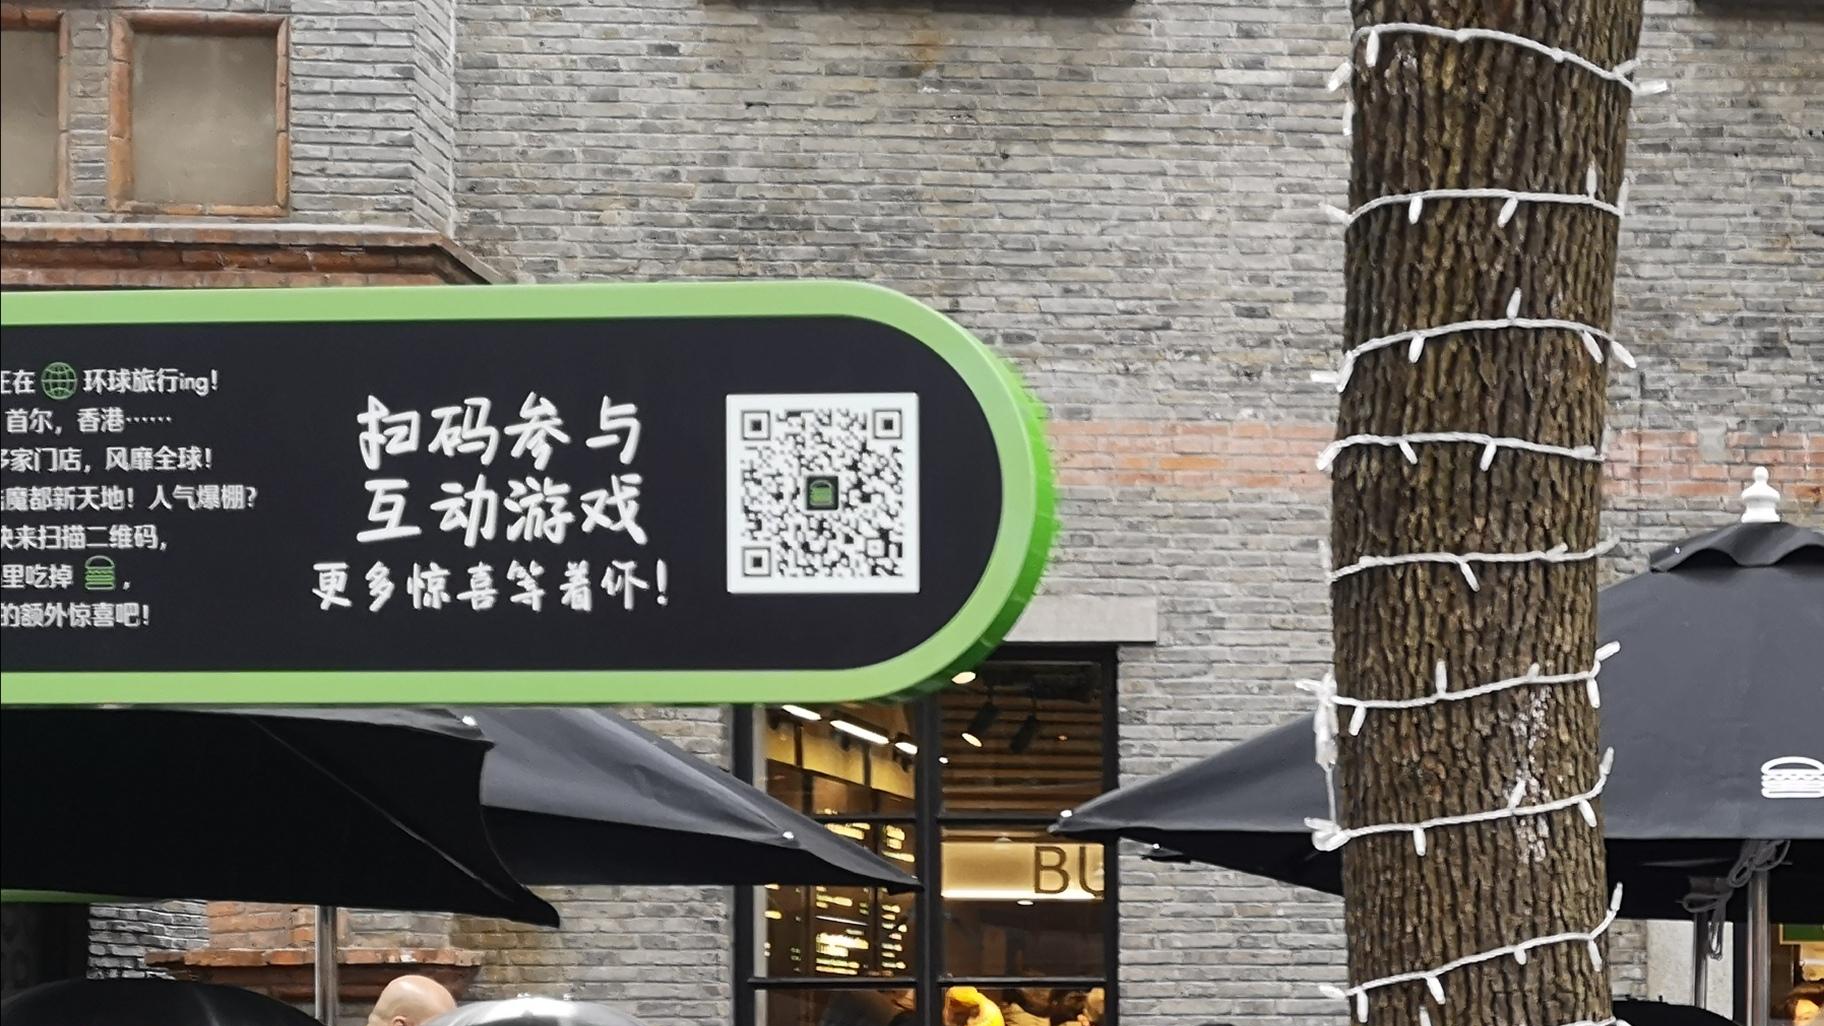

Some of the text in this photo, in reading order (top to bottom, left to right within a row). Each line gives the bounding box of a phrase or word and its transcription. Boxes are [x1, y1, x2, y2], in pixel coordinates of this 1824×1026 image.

[356, 391, 641, 471] 扫码参与
[0, 484, 258, 511] 魔都新天地！人气爆棚？
[356, 473, 649, 549] 互动游戏
